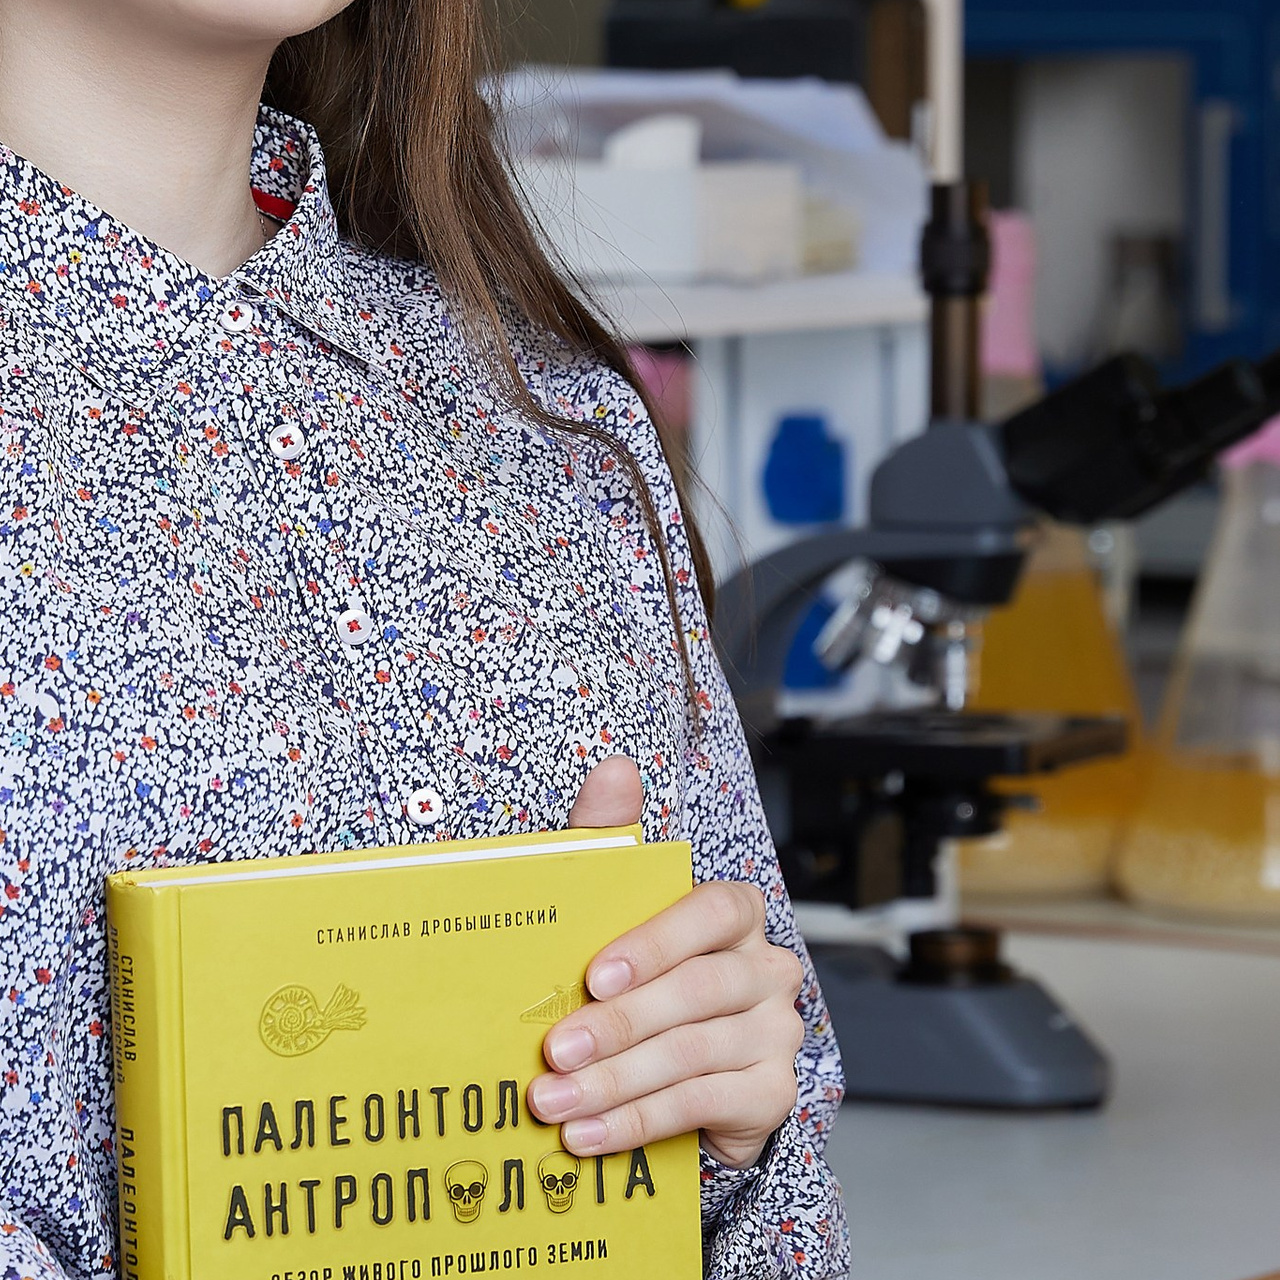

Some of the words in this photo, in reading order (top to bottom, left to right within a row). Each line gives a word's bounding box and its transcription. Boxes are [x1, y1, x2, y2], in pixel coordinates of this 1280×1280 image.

[317, 923, 411, 945] СТАНИСЛАВ
[420, 905, 557, 938] ДРОБЫШЕВСКИЙ
[121, 955, 137, 1062] СТАНИСЛАВ
[222, 1079, 548, 1156] ПАЛЕОНТОЛ
[431, 1246, 538, 1278] ПРОШЛОГО
[547, 1238, 608, 1265] ЗЕМЛИ
